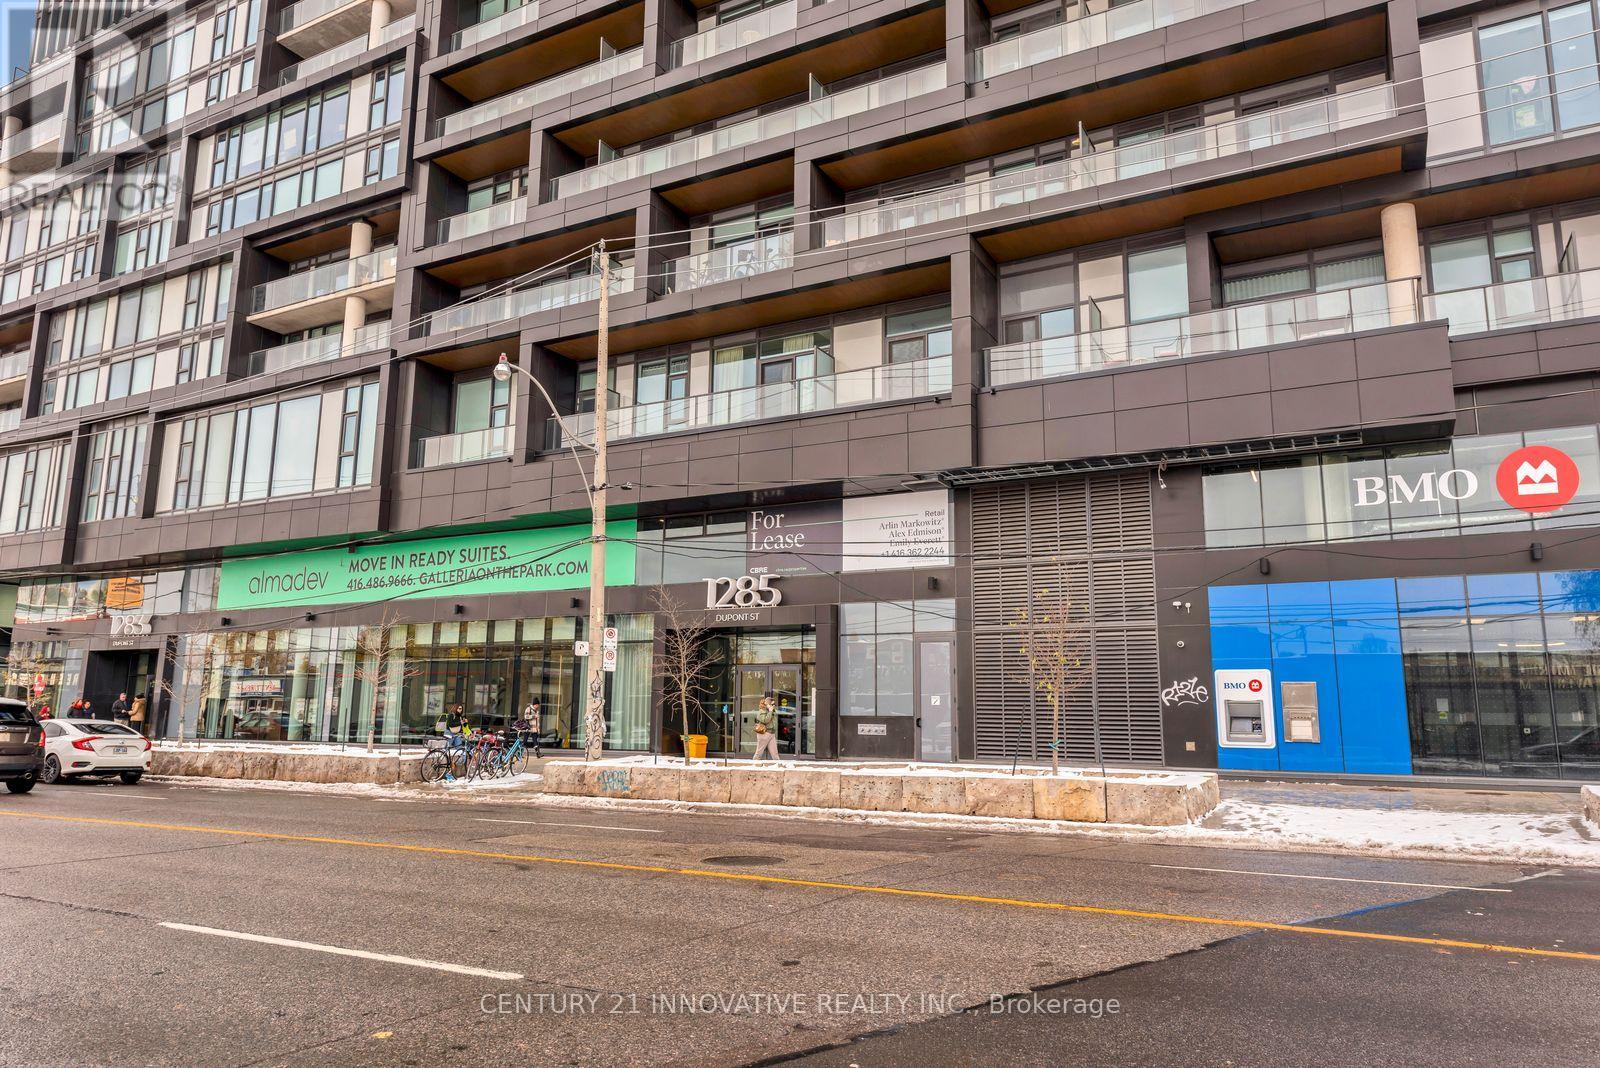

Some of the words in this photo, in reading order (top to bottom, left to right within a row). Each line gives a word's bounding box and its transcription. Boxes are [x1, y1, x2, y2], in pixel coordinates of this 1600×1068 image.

[1353, 468, 1479, 507] BMO
[751, 510, 785, 530] For
[924, 509, 945, 518] Retail
[879, 521, 899, 531] Arlin
[889, 530, 905, 538] Alex
[751, 531, 805, 551] Lease
[924, 546, 945, 556] 2244
[349, 556, 387, 574] MOVE
[391, 554, 405, 570] IN
[409, 548, 456, 569] READY
[459, 544, 511, 564] SUITES.
[248, 565, 329, 595] almadev
[419, 560, 589, 586] GALLERIAONTHEPARK.COM
[702, 574, 782, 608] 1285
[715, 613, 748, 622] DUPONT
[749, 612, 760, 621] ST
[1223, 682, 1247, 690] BMO
